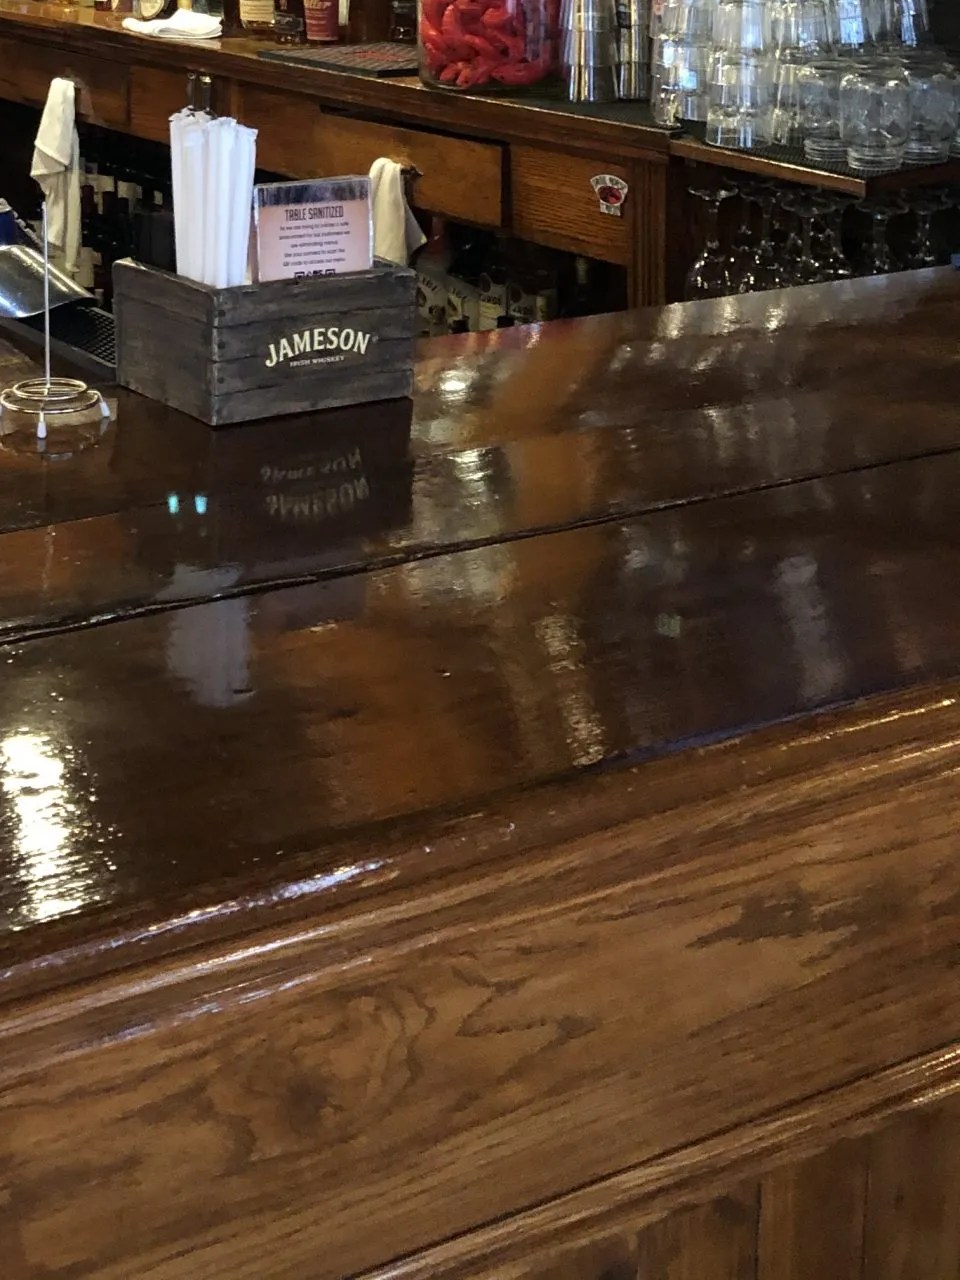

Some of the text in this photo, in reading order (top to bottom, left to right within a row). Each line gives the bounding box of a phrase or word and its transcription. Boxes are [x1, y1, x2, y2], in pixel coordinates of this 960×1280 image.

[284, 205, 344, 221] TABLE SANITIZED
[265, 327, 371, 368] JAMESON
